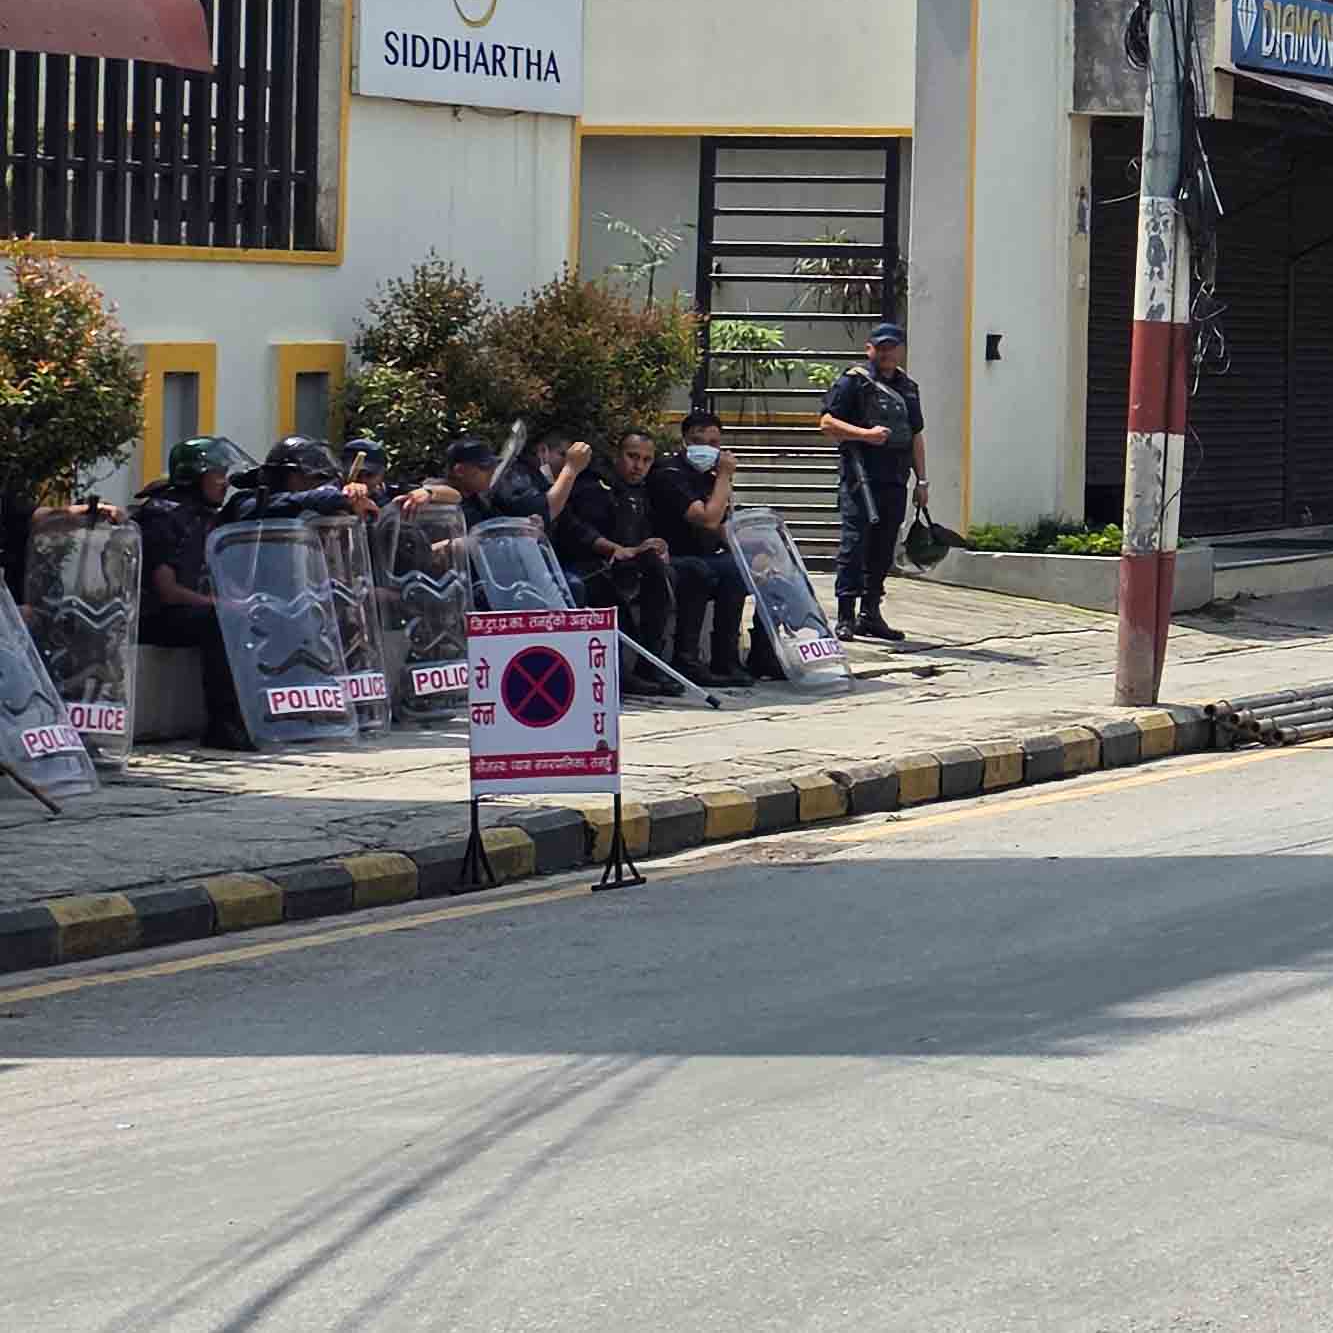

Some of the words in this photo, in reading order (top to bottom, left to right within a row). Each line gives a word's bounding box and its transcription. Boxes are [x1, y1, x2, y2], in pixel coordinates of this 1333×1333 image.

[384, 31, 561, 84] SIDDHARTHA
[415, 667, 469, 692] POLIC
[271, 688, 343, 713] POLICE
[66, 706, 125, 731] OLICE
